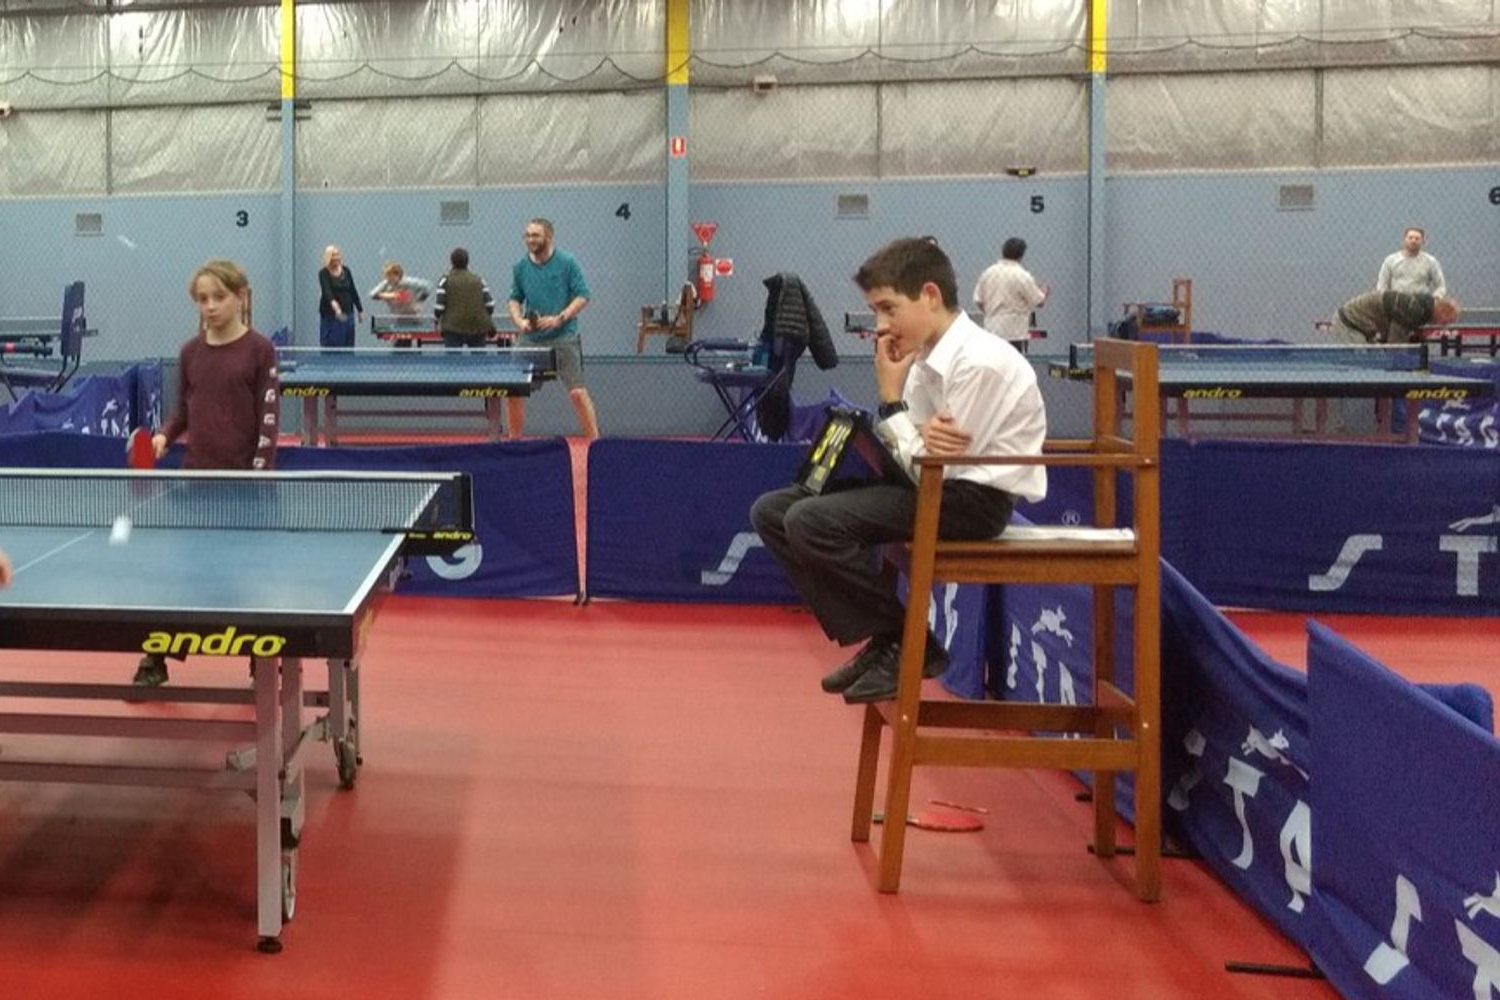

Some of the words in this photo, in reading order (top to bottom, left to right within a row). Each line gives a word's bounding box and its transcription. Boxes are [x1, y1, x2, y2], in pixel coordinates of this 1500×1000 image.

[1488, 186, 1500, 206] 6
[615, 202, 631, 221] 4
[1030, 195, 1045, 214] 5
[235, 209, 249, 227] 3
[282, 385, 330, 397] andro
[460, 386, 508, 398] andro
[1182, 387, 1243, 399] andro
[1405, 387, 1469, 399] andro
[432, 528, 473, 541] andro
[141, 625, 287, 657] andro
